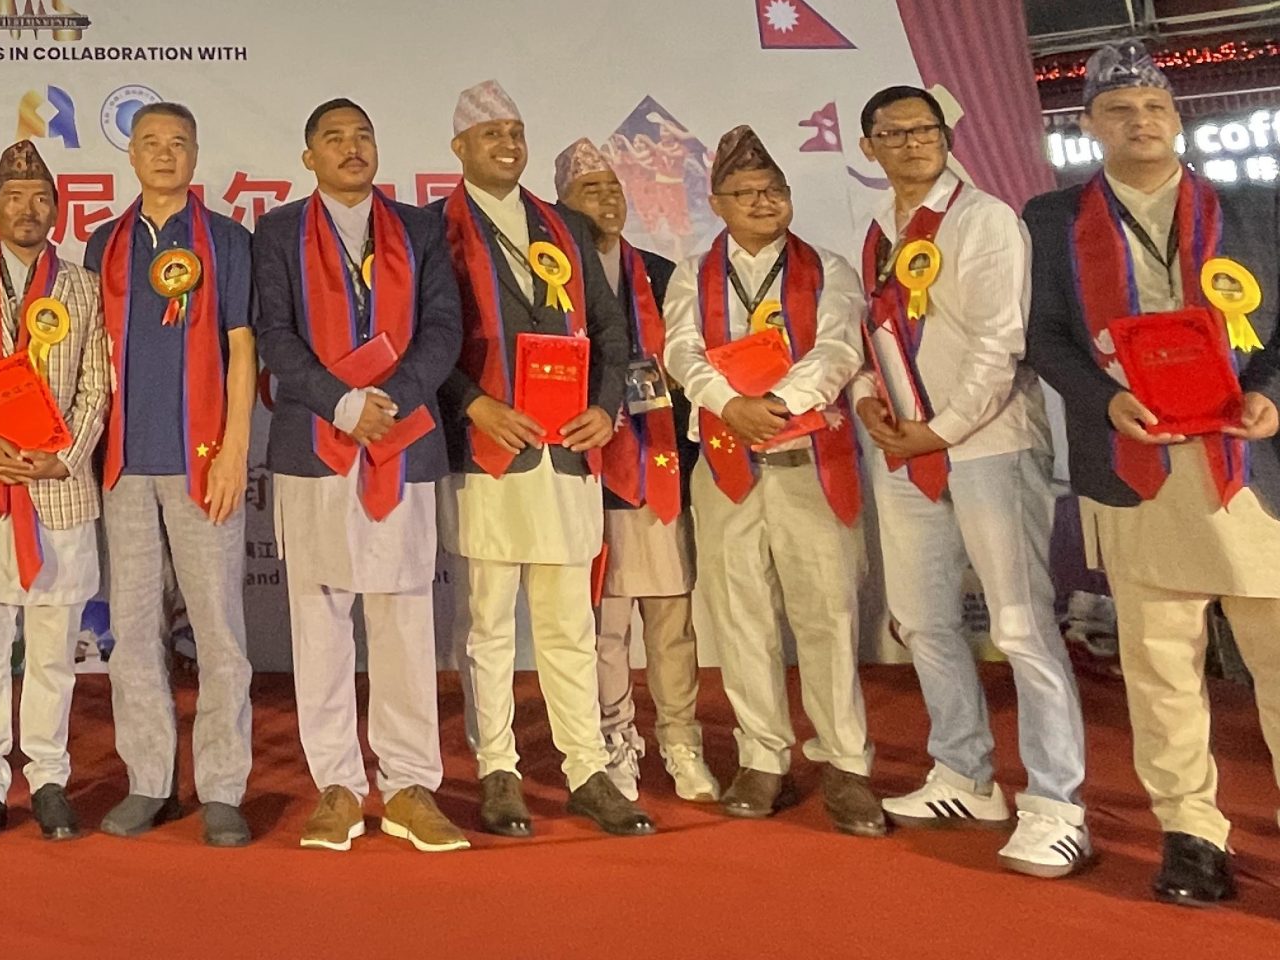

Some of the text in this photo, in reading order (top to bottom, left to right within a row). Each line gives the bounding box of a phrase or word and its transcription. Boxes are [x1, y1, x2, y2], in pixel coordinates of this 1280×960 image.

[9, 47, 28, 61] IN
[33, 47, 193, 61] COLLABORATION
[197, 46, 248, 61] WITH
